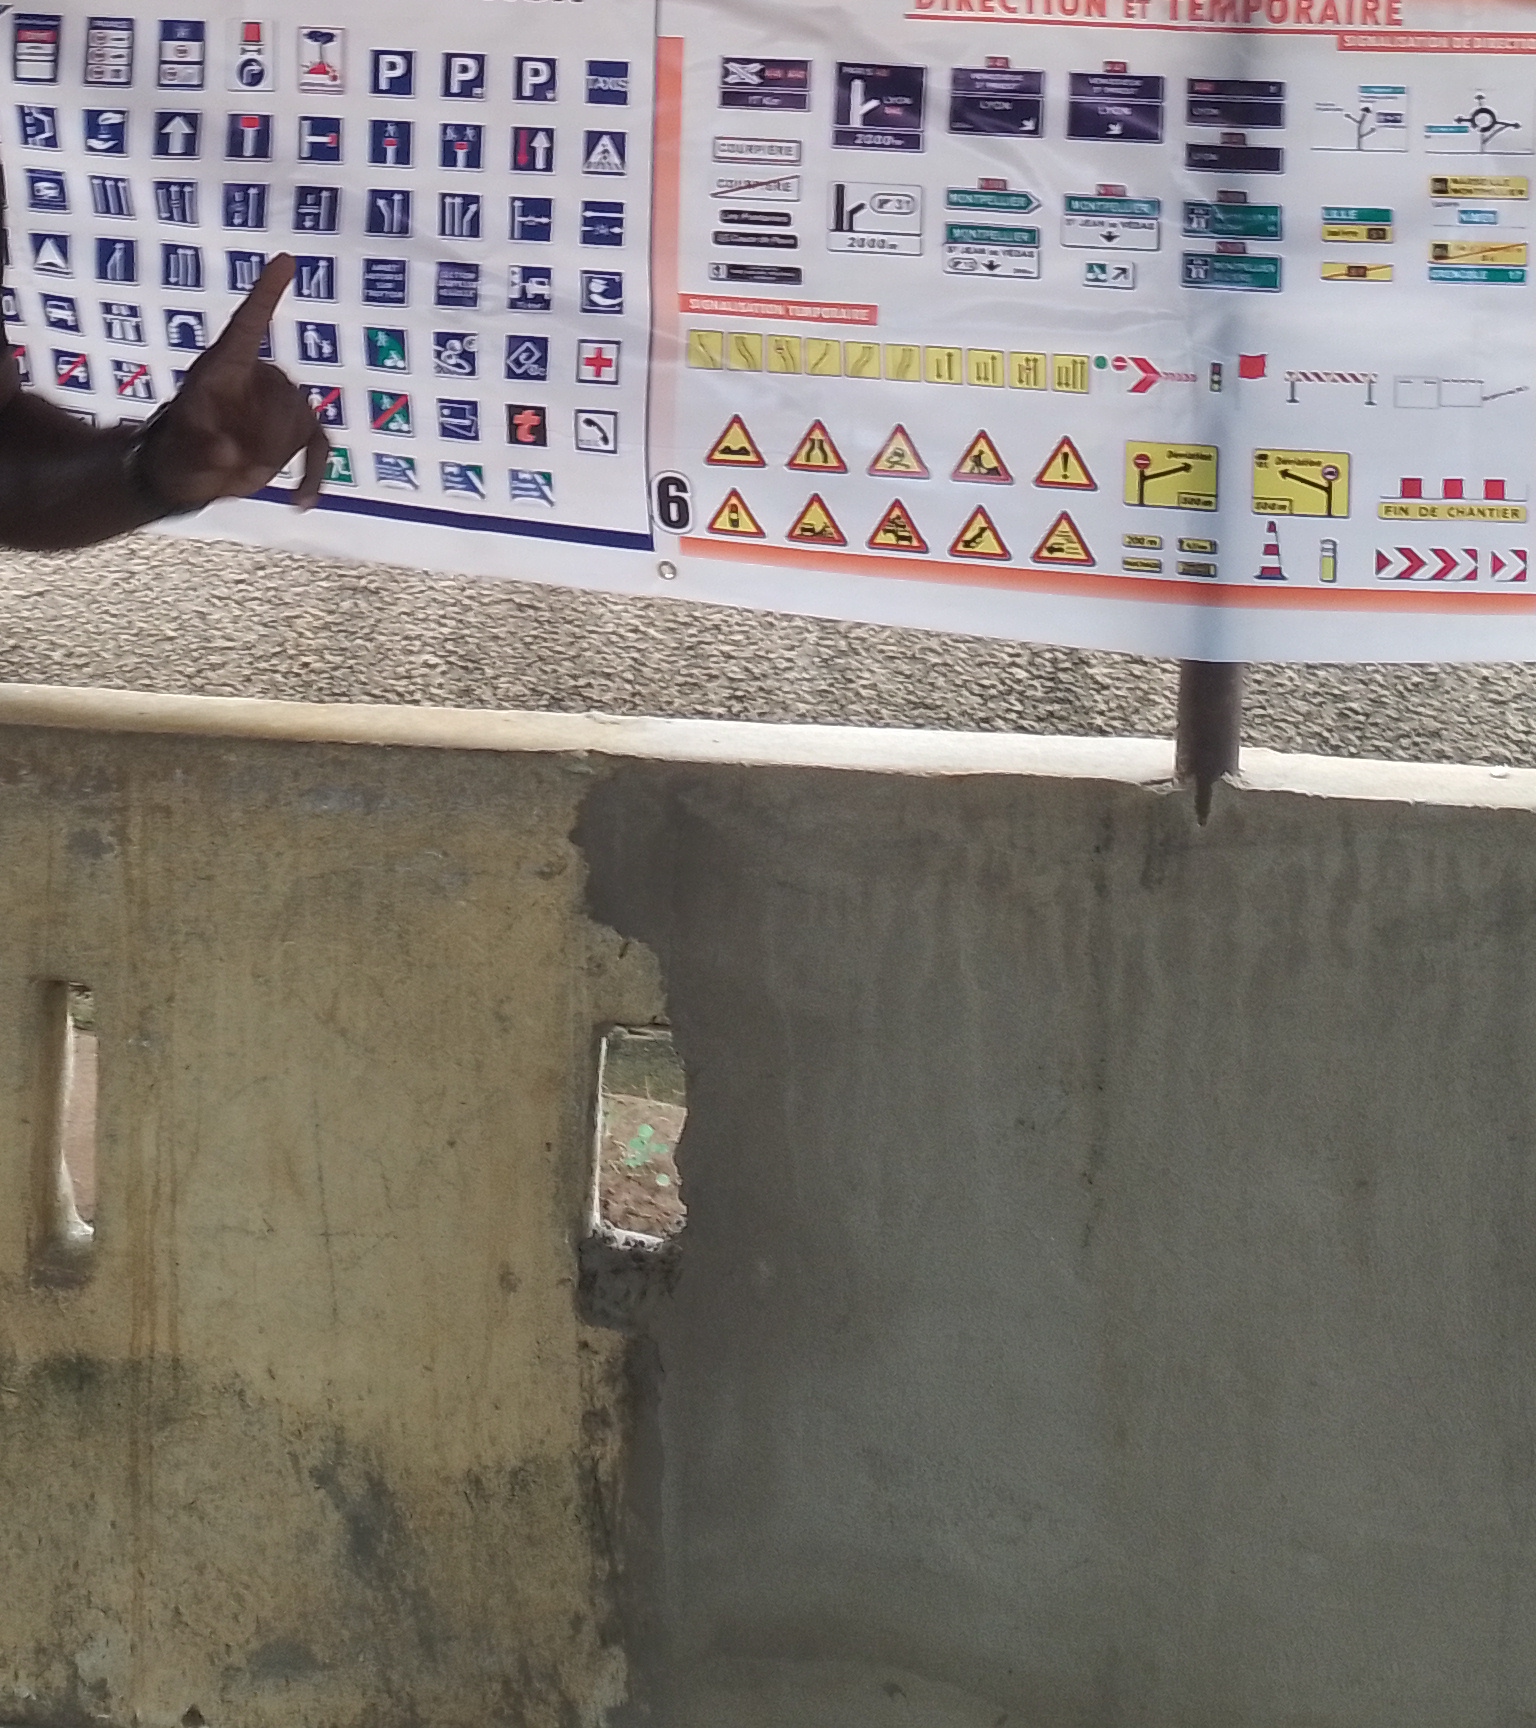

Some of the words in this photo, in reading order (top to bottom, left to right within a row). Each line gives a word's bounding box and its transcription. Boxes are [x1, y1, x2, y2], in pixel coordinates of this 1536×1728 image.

[657, 476, 690, 529] 6
[1383, 505, 1411, 519] FIN
[1418, 506, 1439, 519] DE
[1446, 506, 1521, 520] CHANTIER
